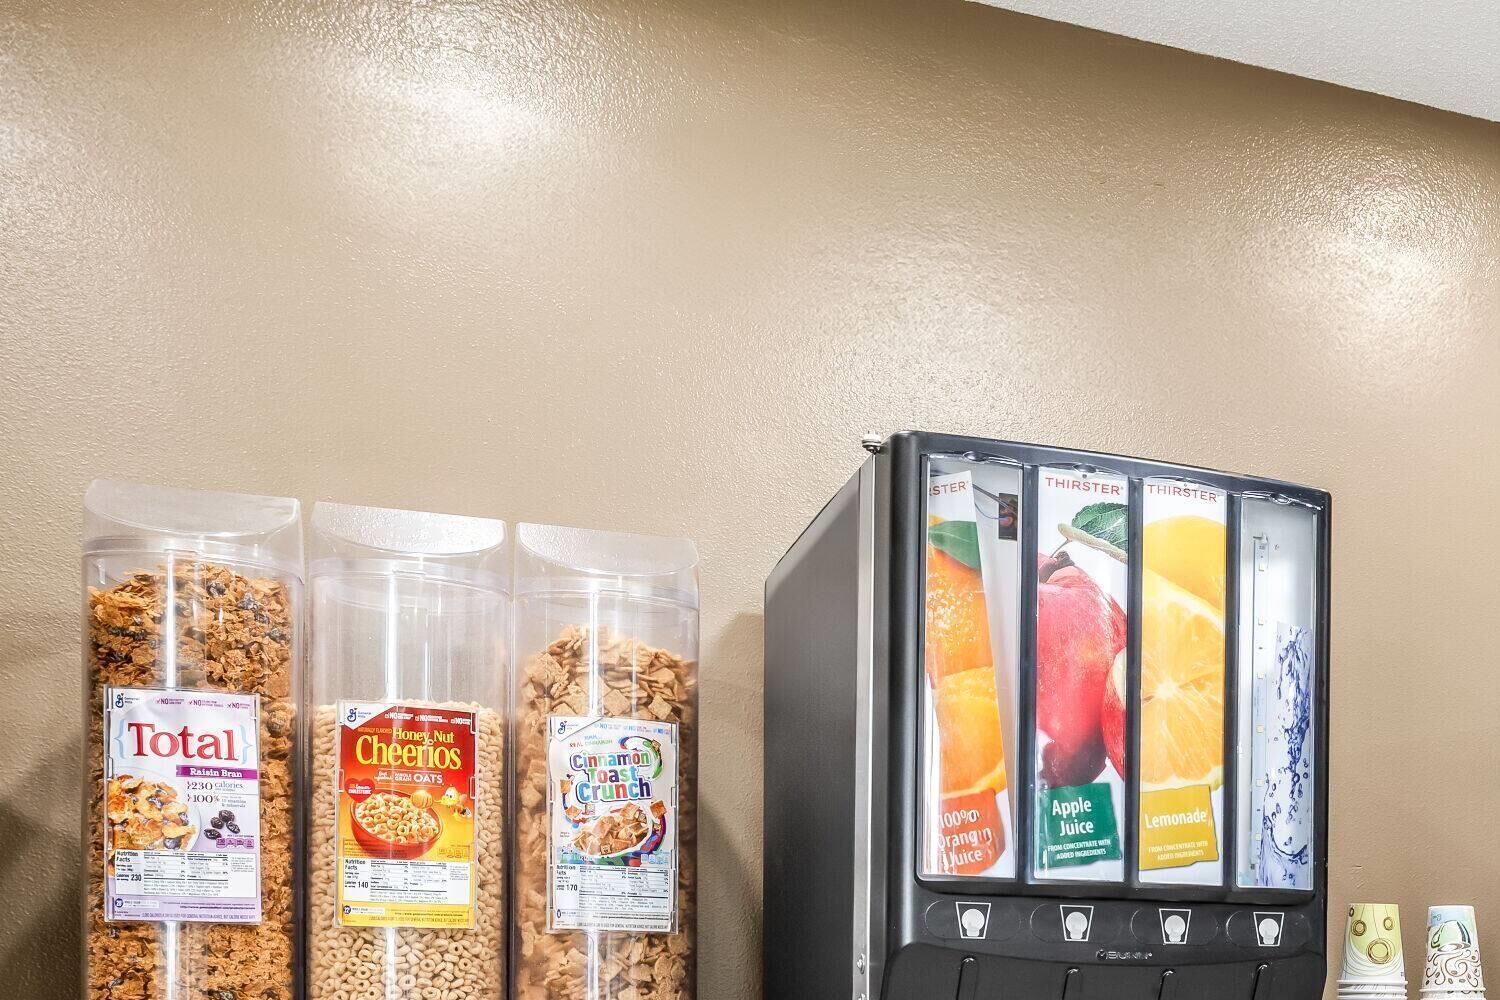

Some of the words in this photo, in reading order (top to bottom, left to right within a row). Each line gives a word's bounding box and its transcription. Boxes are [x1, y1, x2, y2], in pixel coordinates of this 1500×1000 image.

[1045, 477, 1120, 496] THIRSTER
[1147, 484, 1217, 502] THIRSTER
[128, 722, 240, 762] Total
[393, 727, 431, 744] Honey
[433, 730, 455, 744] Nut
[355, 734, 462, 770] Cheerios
[572, 750, 650, 769] Cinnamon
[190, 768, 220, 778] Raisin
[221, 770, 243, 778] Bran
[413, 773, 443, 784] OATS
[587, 765, 638, 783] Toast
[191, 782, 213, 791] 230
[578, 776, 652, 802] Crunch
[1052, 796, 1092, 819] Apple
[1144, 807, 1207, 829] Lemonade
[1060, 819, 1094, 837] Juice
[1047, 844, 1063, 852] FROM
[1063, 840, 1098, 850] CONCENTRATE
[1098, 838, 1111, 846] WITH
[1075, 848, 1106, 857] INGREDIENTS
[130, 874, 142, 882] 230
[357, 881, 369, 889] 140
